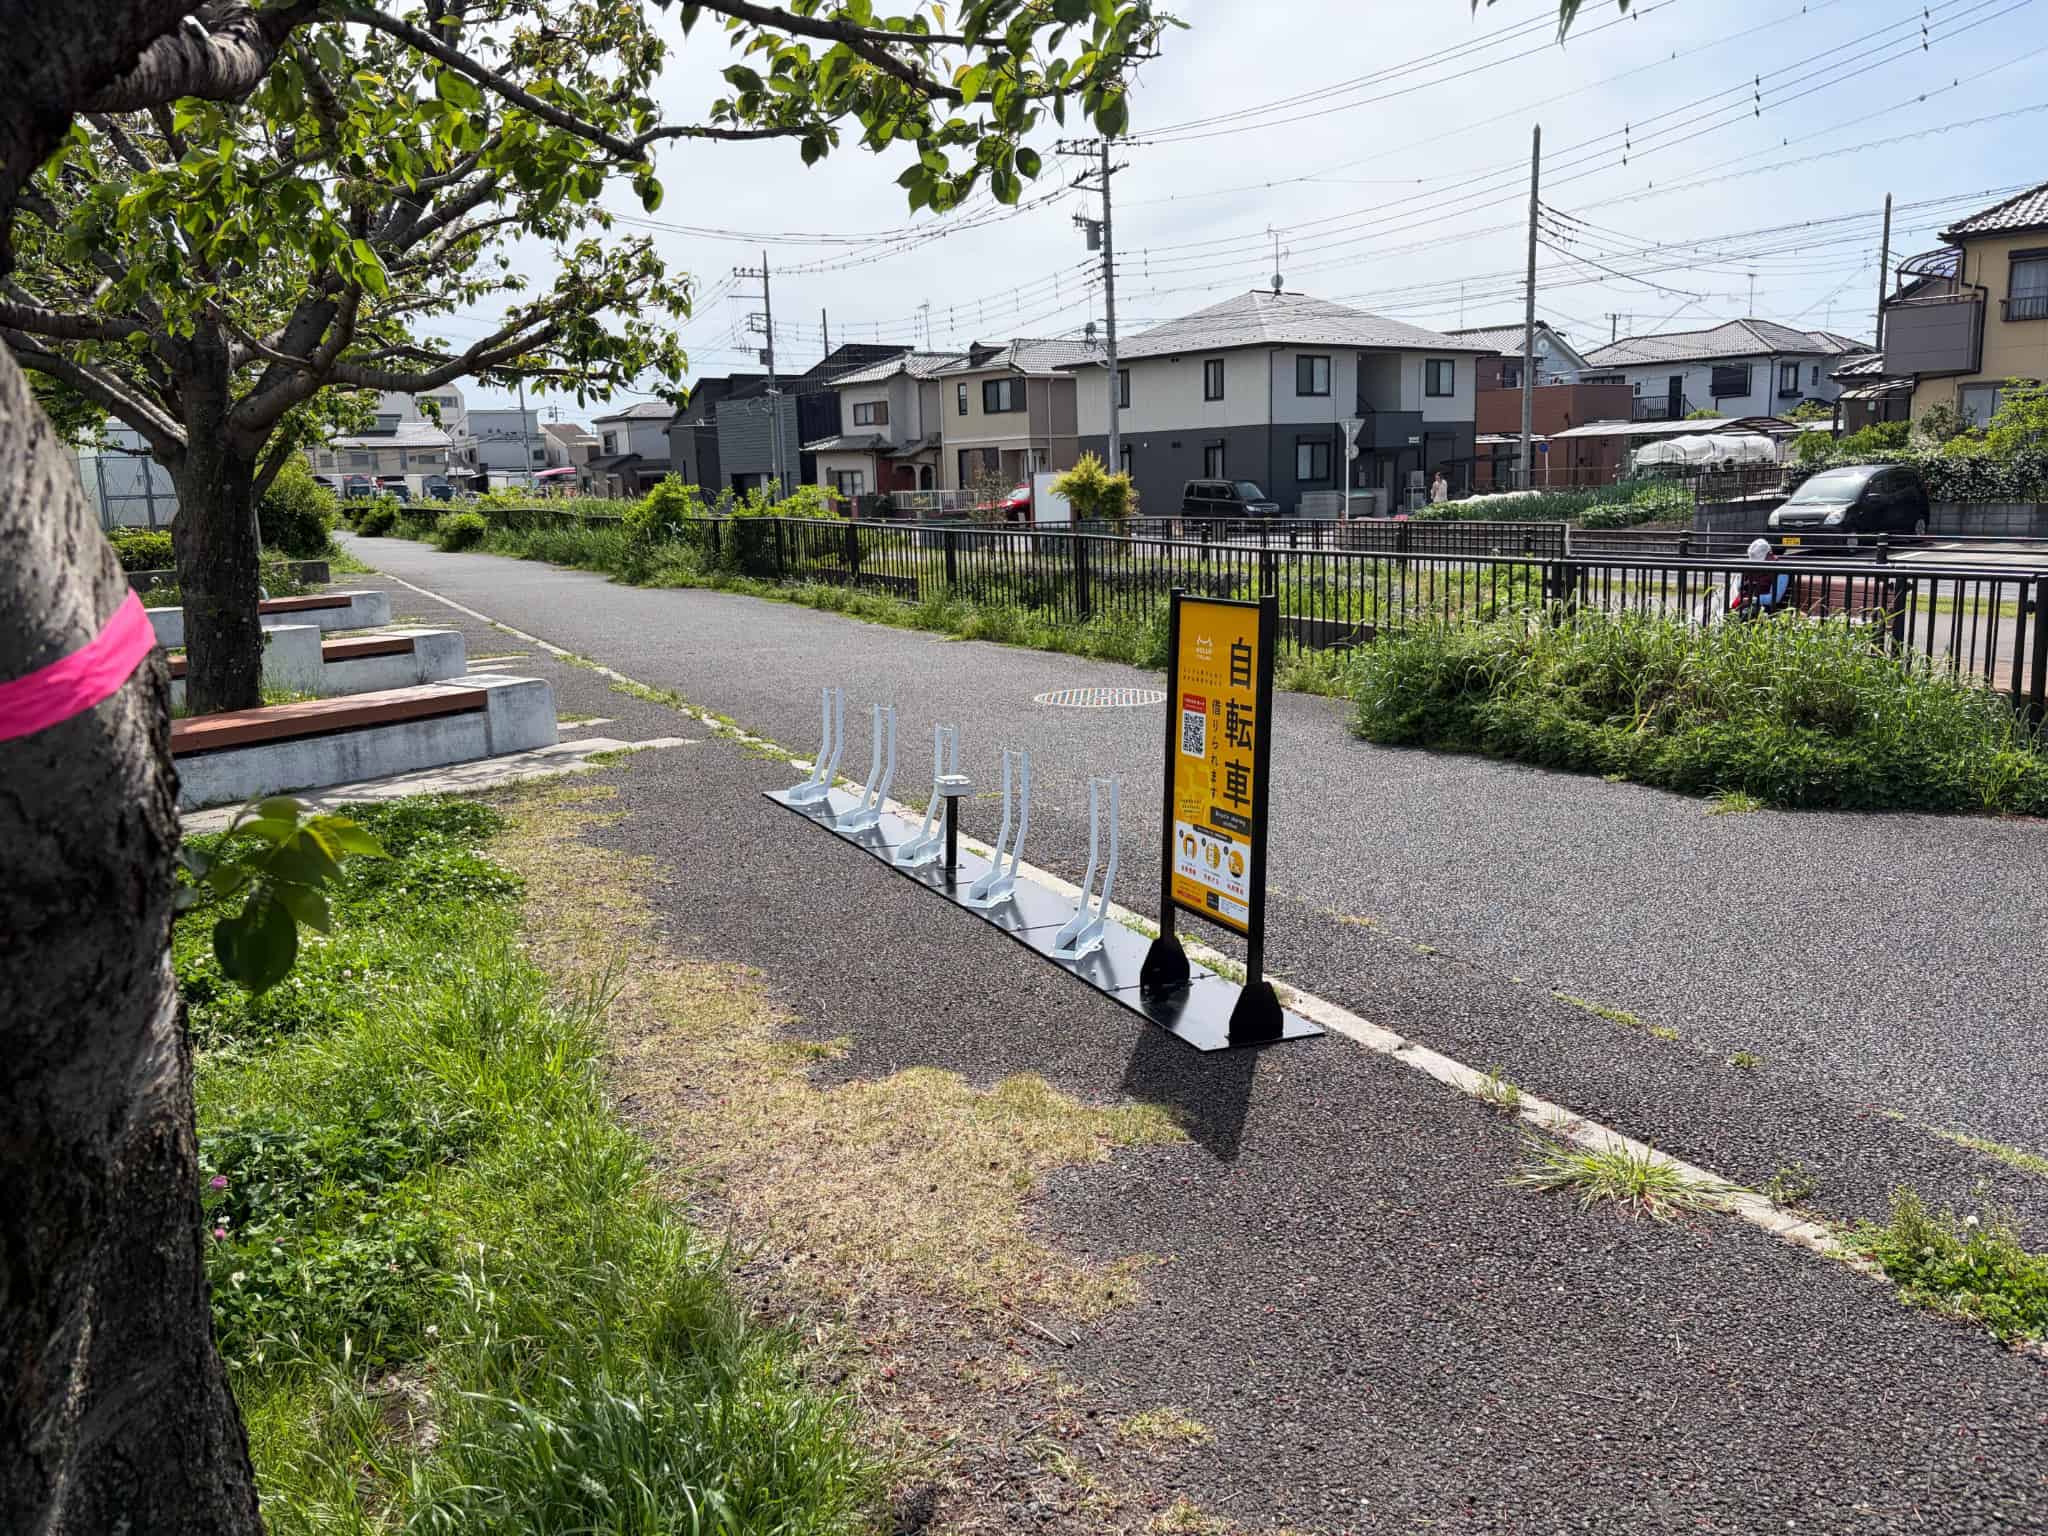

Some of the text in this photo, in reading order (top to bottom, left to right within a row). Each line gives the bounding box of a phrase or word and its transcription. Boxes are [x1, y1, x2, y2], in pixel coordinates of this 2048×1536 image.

[1210, 699, 1221, 800] 借りられます
[1223, 637, 1253, 808] 自転車
